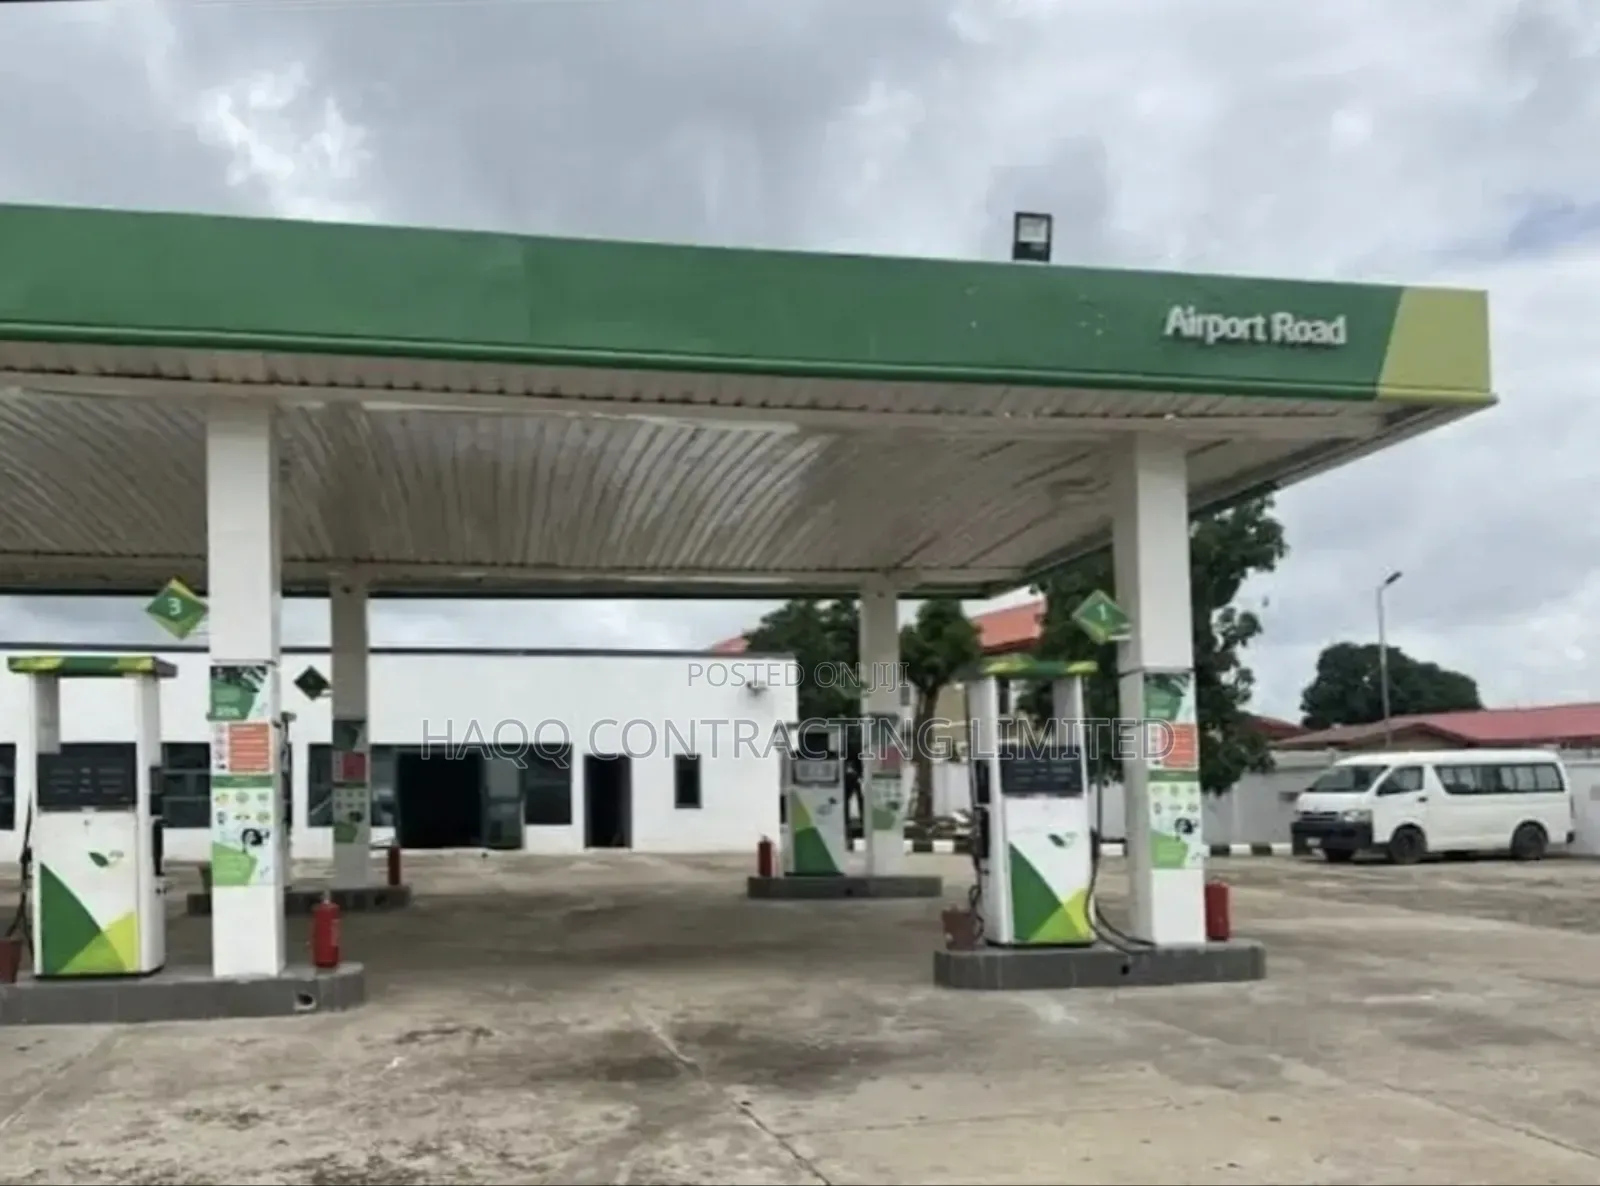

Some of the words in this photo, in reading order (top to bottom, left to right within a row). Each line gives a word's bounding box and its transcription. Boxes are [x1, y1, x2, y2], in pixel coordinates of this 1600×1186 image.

[1164, 304, 1267, 345] Airport
[1270, 311, 1347, 345] Road
[167, 597, 182, 616] 3
